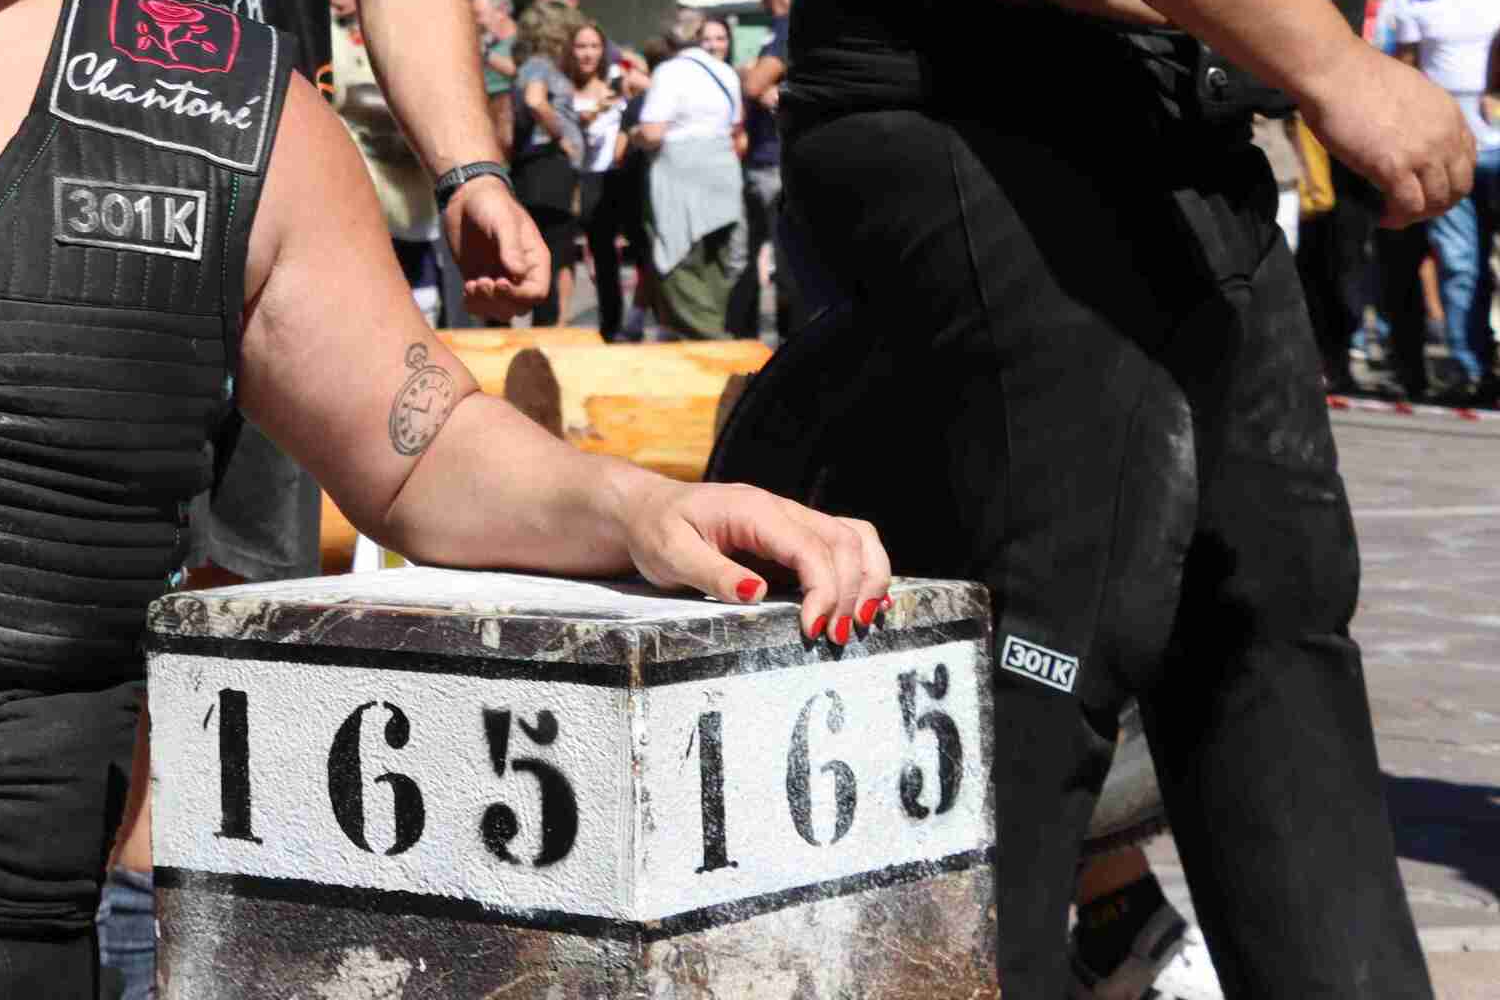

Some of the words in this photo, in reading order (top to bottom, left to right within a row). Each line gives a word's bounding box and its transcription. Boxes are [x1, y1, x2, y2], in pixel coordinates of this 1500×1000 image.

[65, 51, 262, 129] Chantoné
[202, 688, 580, 867] 165
[684, 663, 964, 874] 165
